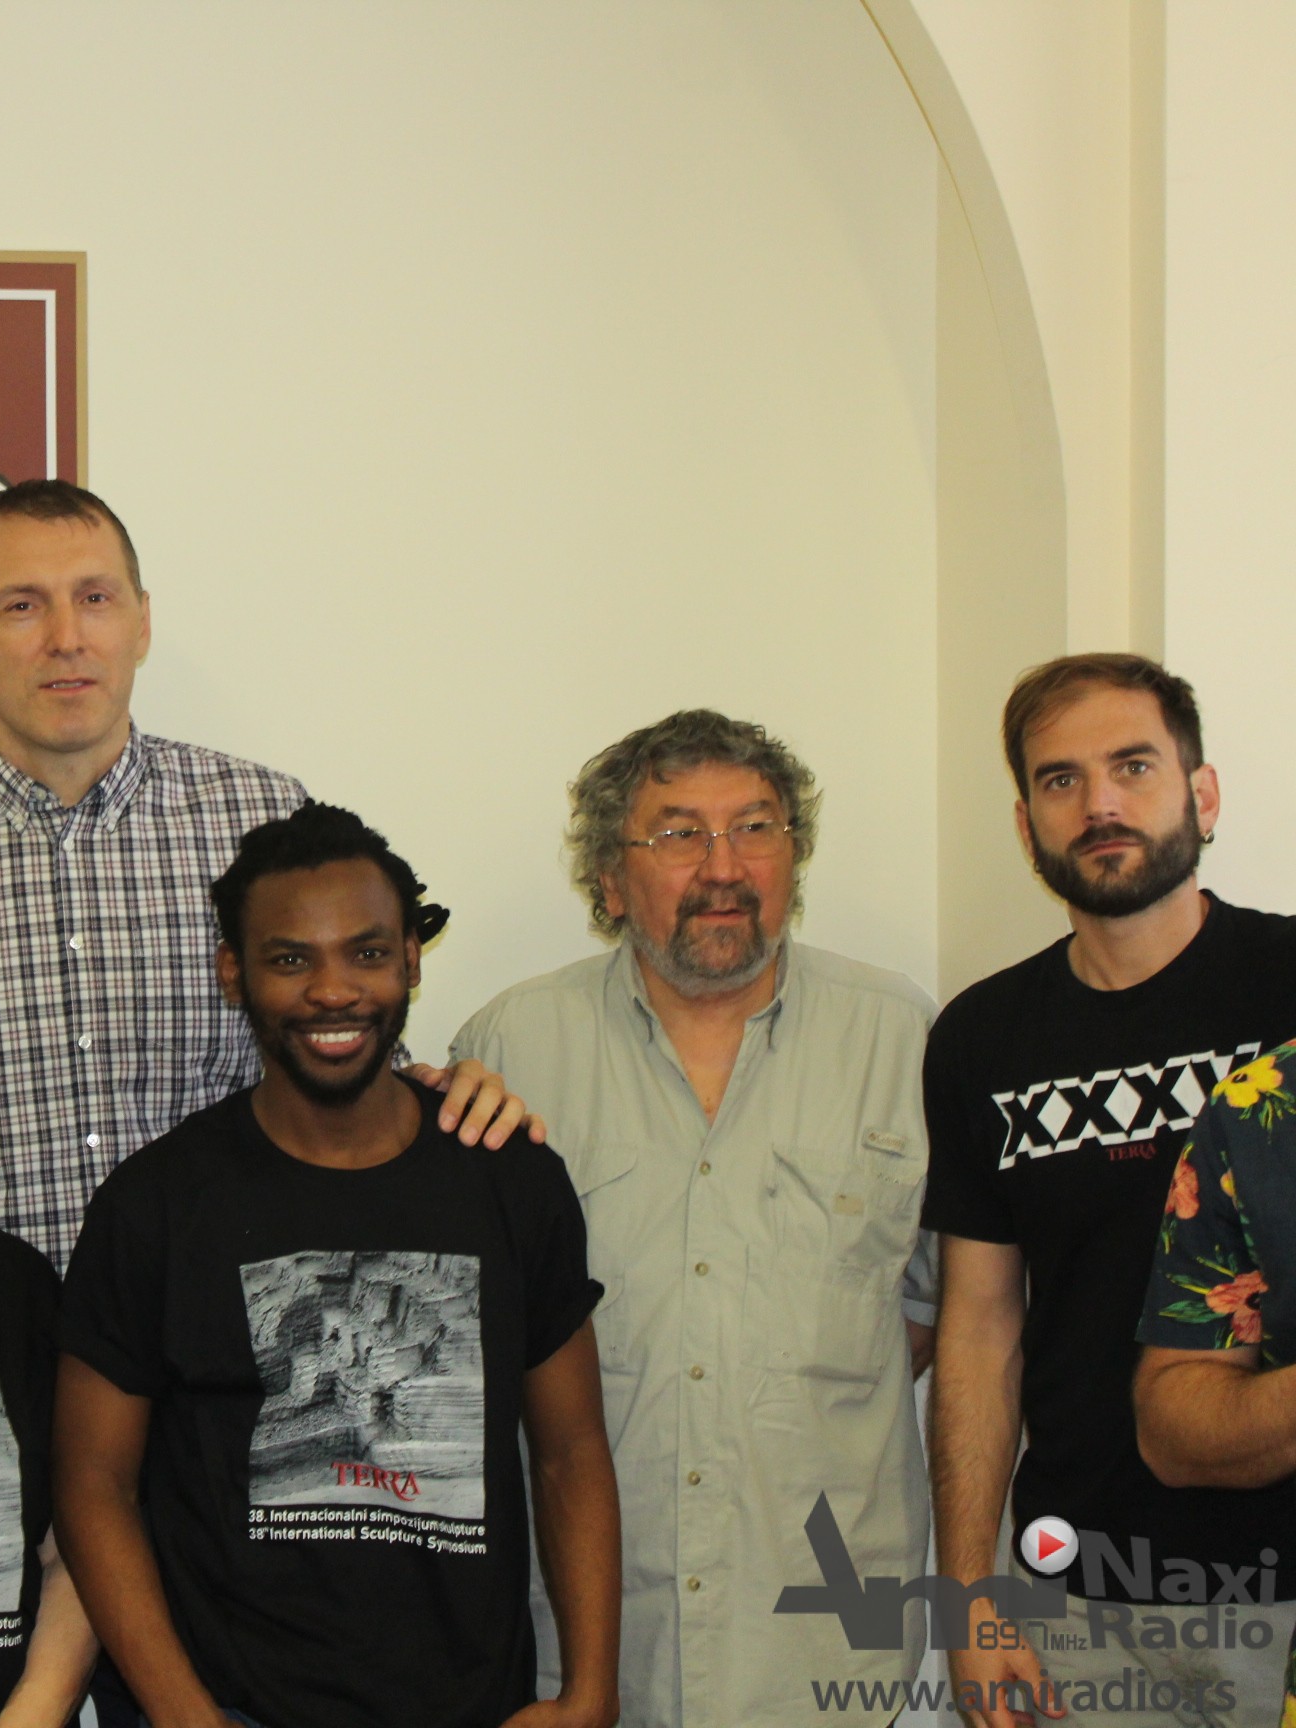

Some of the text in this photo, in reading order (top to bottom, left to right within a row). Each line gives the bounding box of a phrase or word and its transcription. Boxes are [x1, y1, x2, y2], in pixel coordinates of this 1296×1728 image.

[331, 1461, 422, 1502] TERRA
[249, 1509, 267, 1523] 38.
[270, 1508, 368, 1523] Internacionalni
[369, 1509, 439, 1531] simpozijum
[270, 1526, 356, 1540] International
[360, 1527, 423, 1546] Sculpture
[427, 1535, 487, 1555] Symposium
